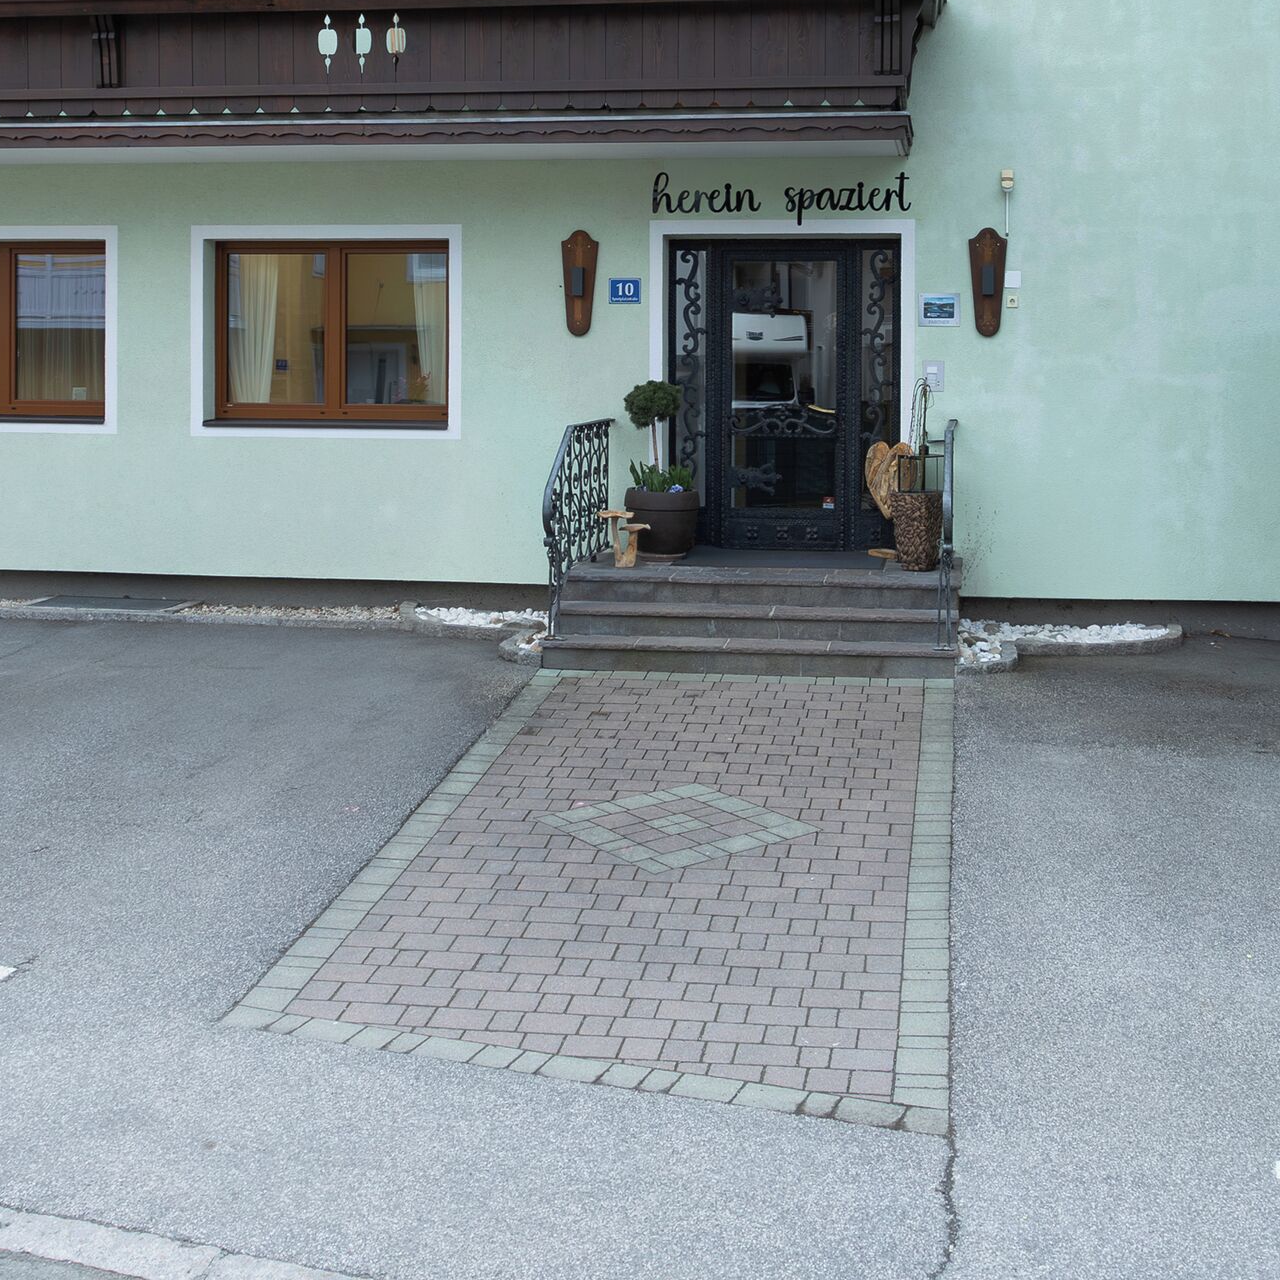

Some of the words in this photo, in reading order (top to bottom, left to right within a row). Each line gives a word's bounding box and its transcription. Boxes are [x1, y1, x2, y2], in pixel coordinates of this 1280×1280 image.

[652, 172, 761, 214] herein
[784, 172, 911, 226] spaziert
[616, 282, 634, 296] 10
